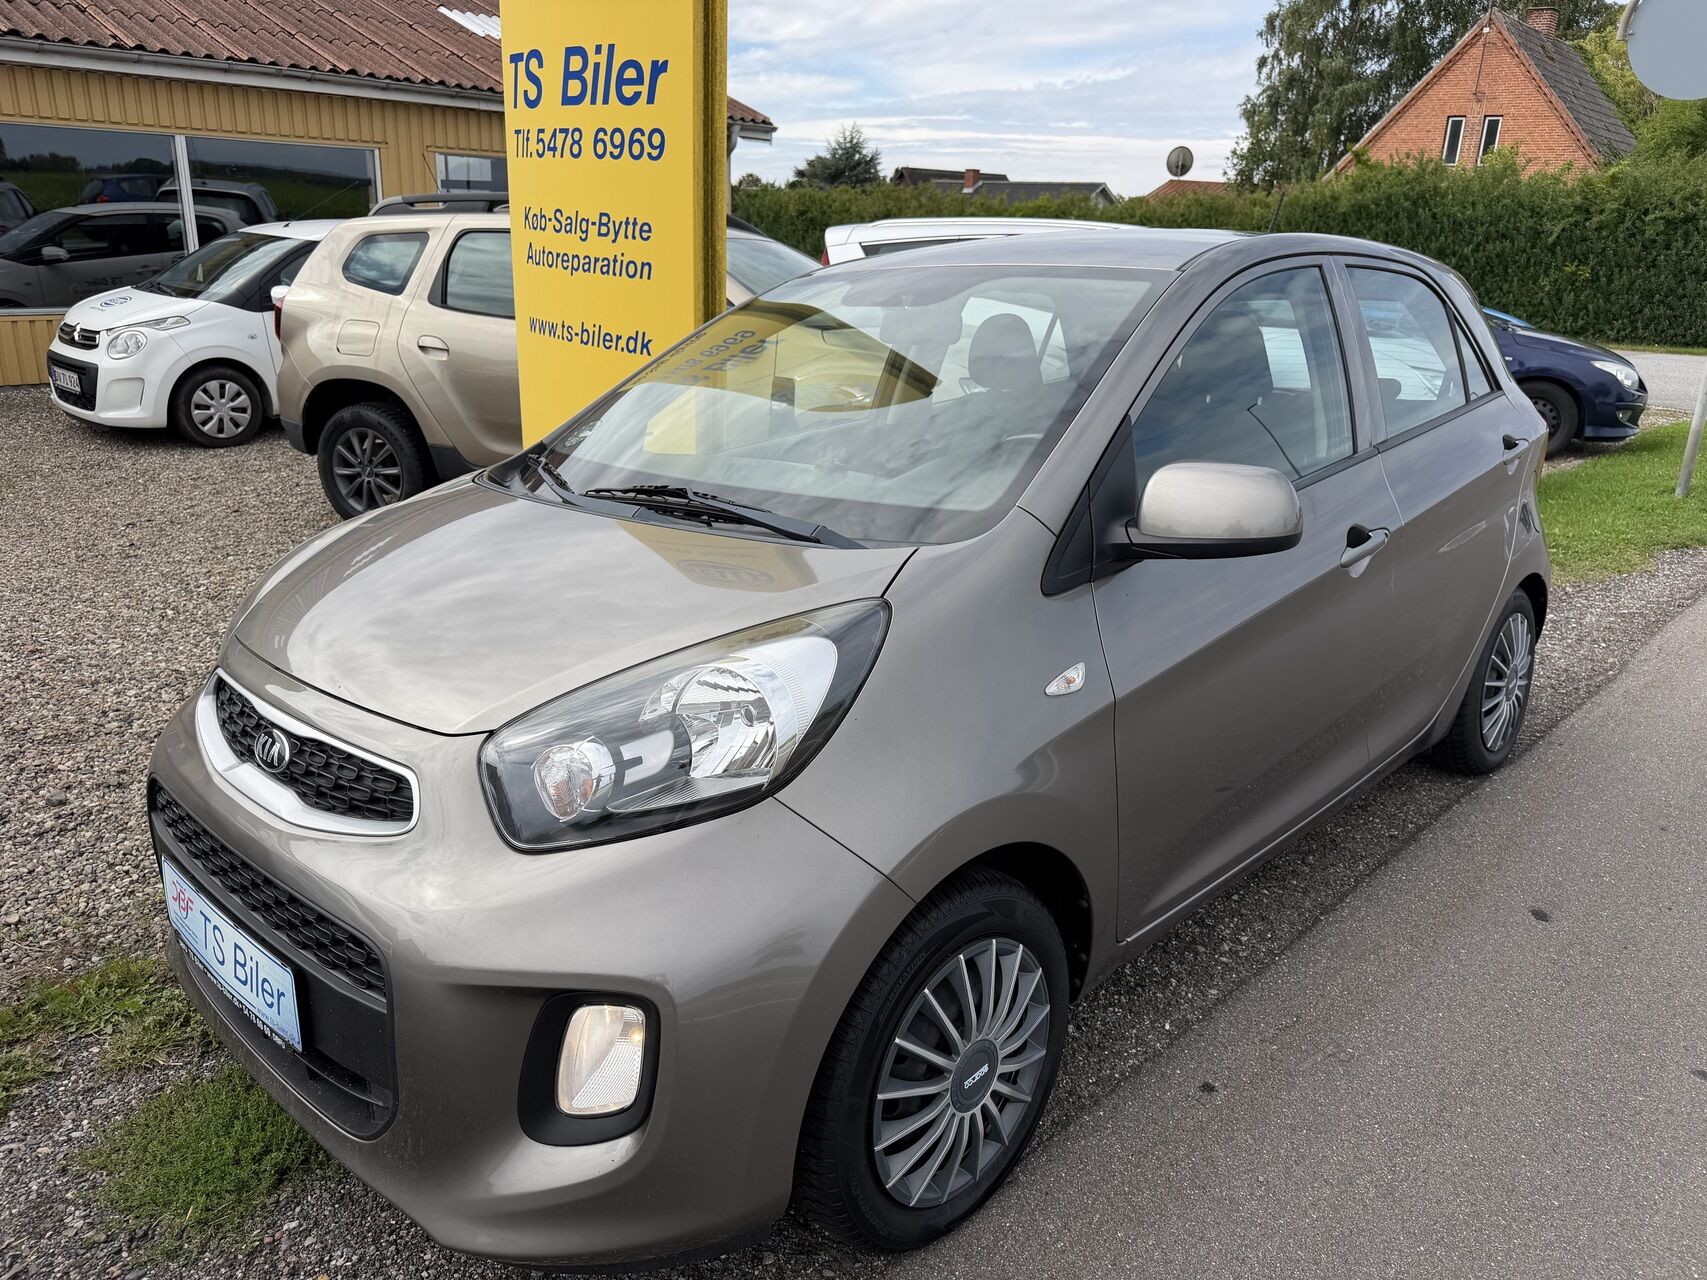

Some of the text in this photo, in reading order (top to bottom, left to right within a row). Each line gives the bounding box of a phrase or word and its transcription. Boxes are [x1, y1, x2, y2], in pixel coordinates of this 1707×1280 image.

[509, 43, 669, 109] TS Biler
[592, 127, 666, 161] 6969
[524, 206, 652, 243] Køb-Salg-Bytte
[526, 242, 652, 280] Autoreparation
[529, 316, 652, 356] www.ts-biler.dk
[200, 909, 225, 967] TS
[234, 942, 286, 1016] Biler
